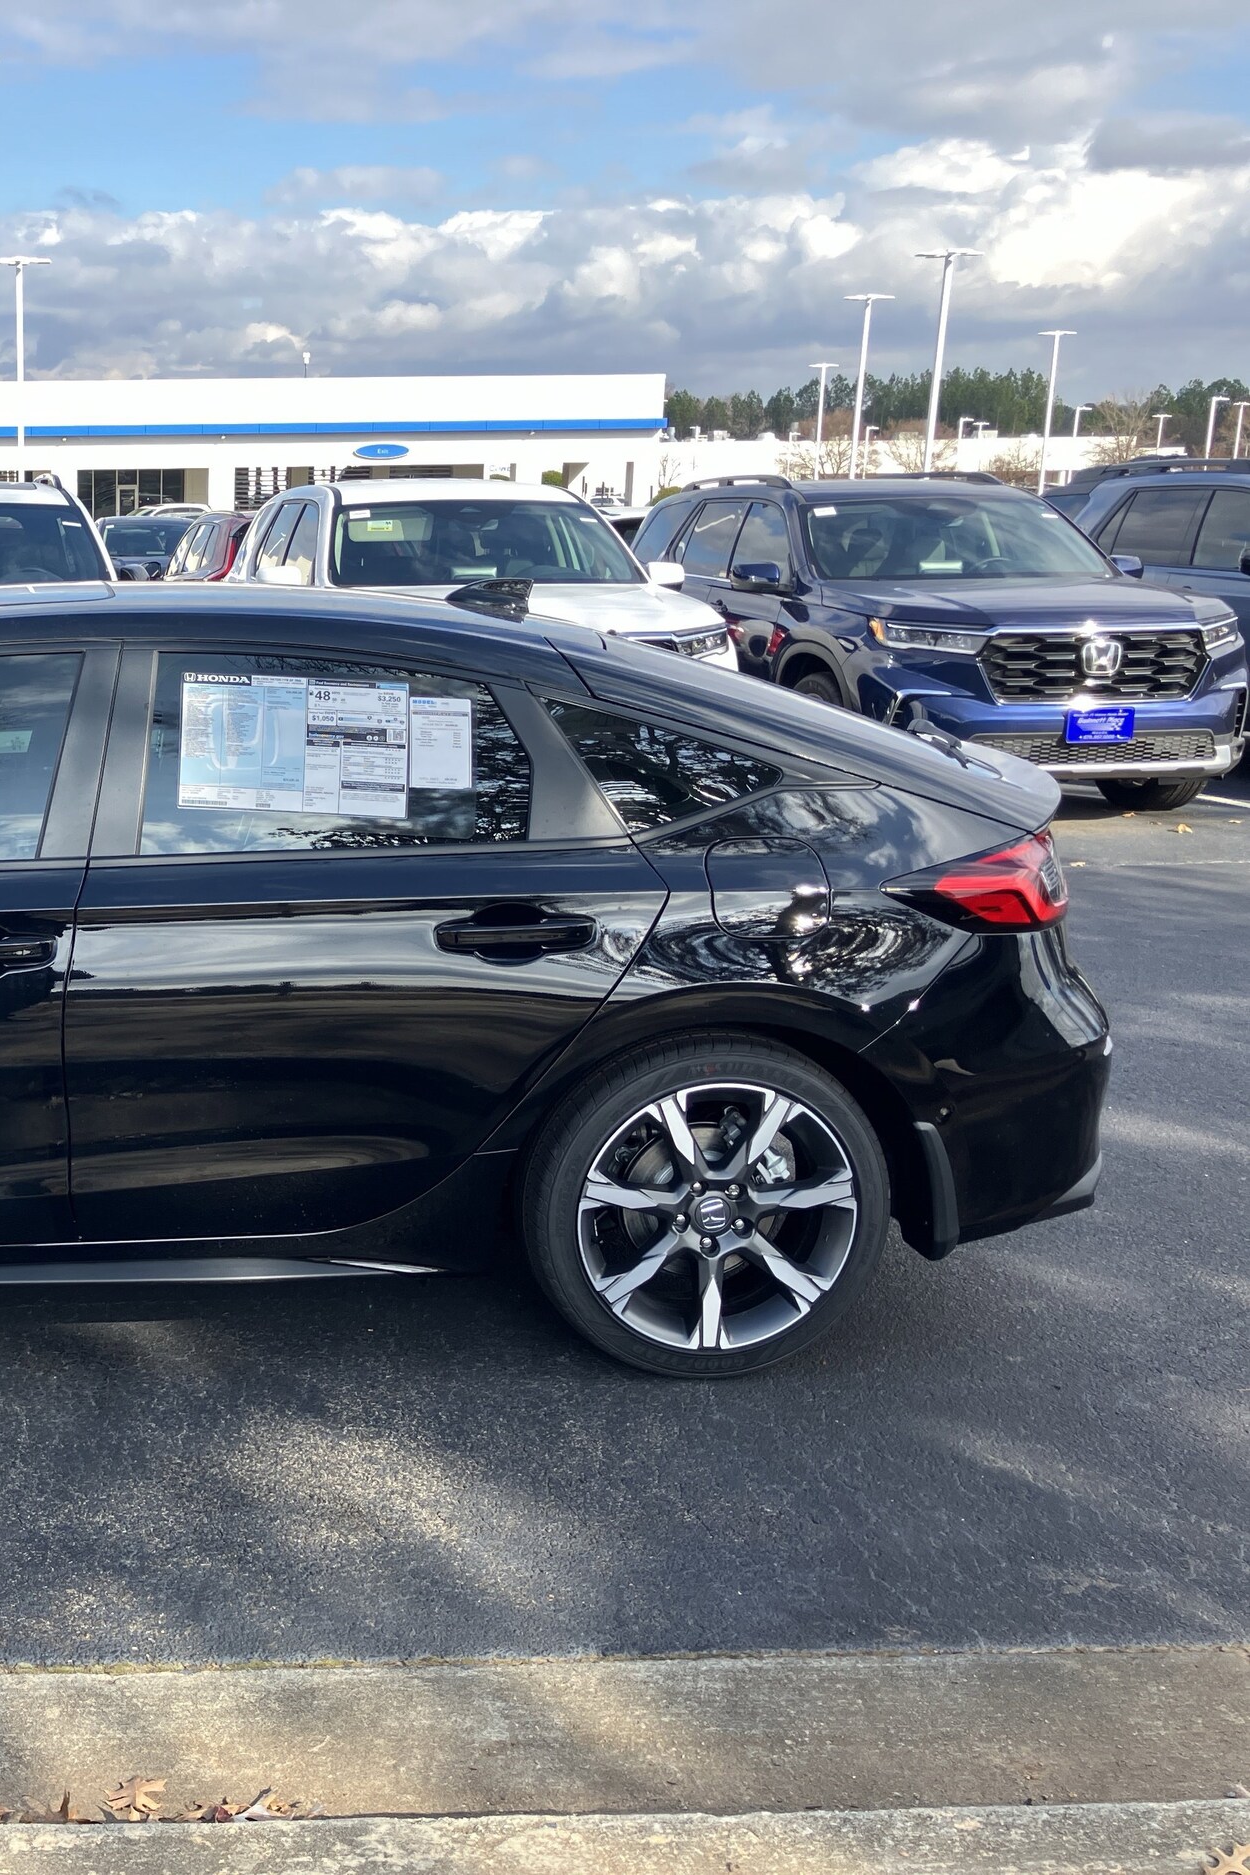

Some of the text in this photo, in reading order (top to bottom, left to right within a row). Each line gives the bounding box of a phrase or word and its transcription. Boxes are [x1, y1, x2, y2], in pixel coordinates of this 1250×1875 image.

[197, 675, 250, 684] HONDA
[315, 690, 331, 701] 48
[377, 695, 401, 703] $3,250
